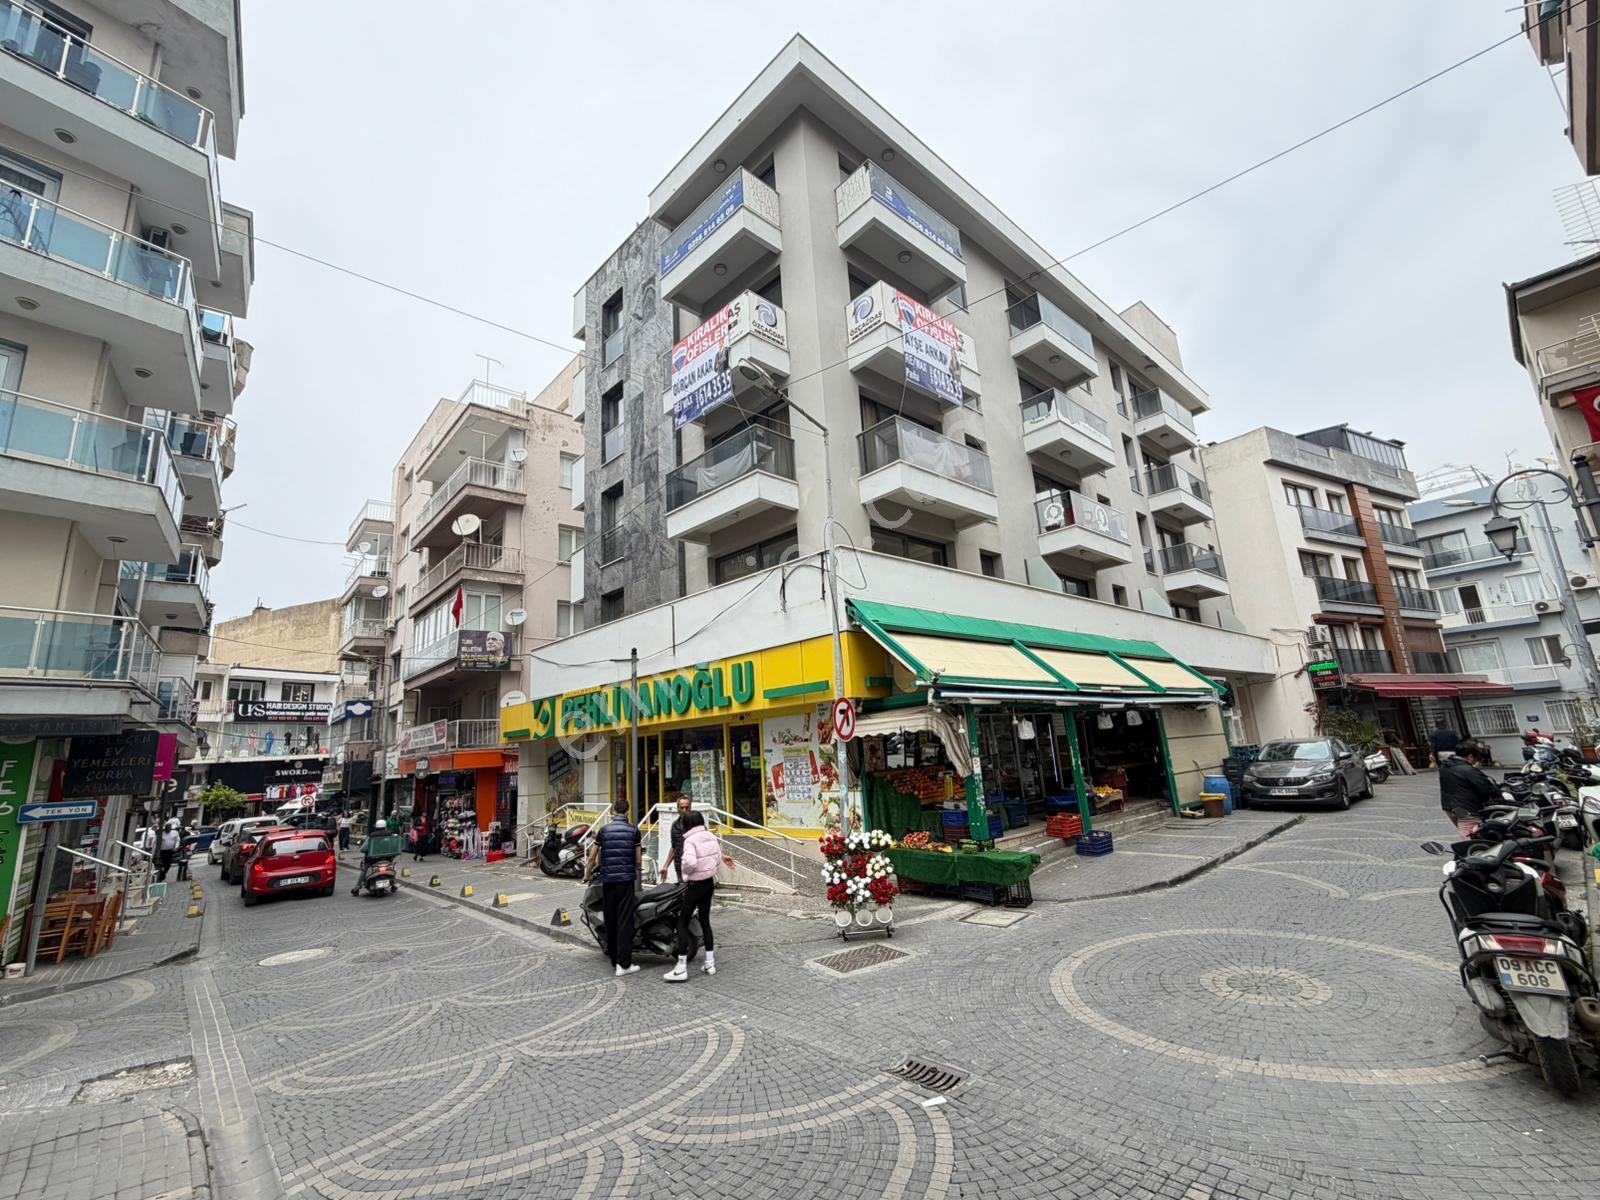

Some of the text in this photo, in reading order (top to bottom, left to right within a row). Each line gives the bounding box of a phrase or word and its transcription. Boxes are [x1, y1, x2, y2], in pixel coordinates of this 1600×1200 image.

[561, 660, 755, 730] PEHLİVANOĞLU
[275, 768, 308, 777] SWORD
[1500, 958, 1557, 975] 09 ACC
[1516, 973, 1551, 988] 608
